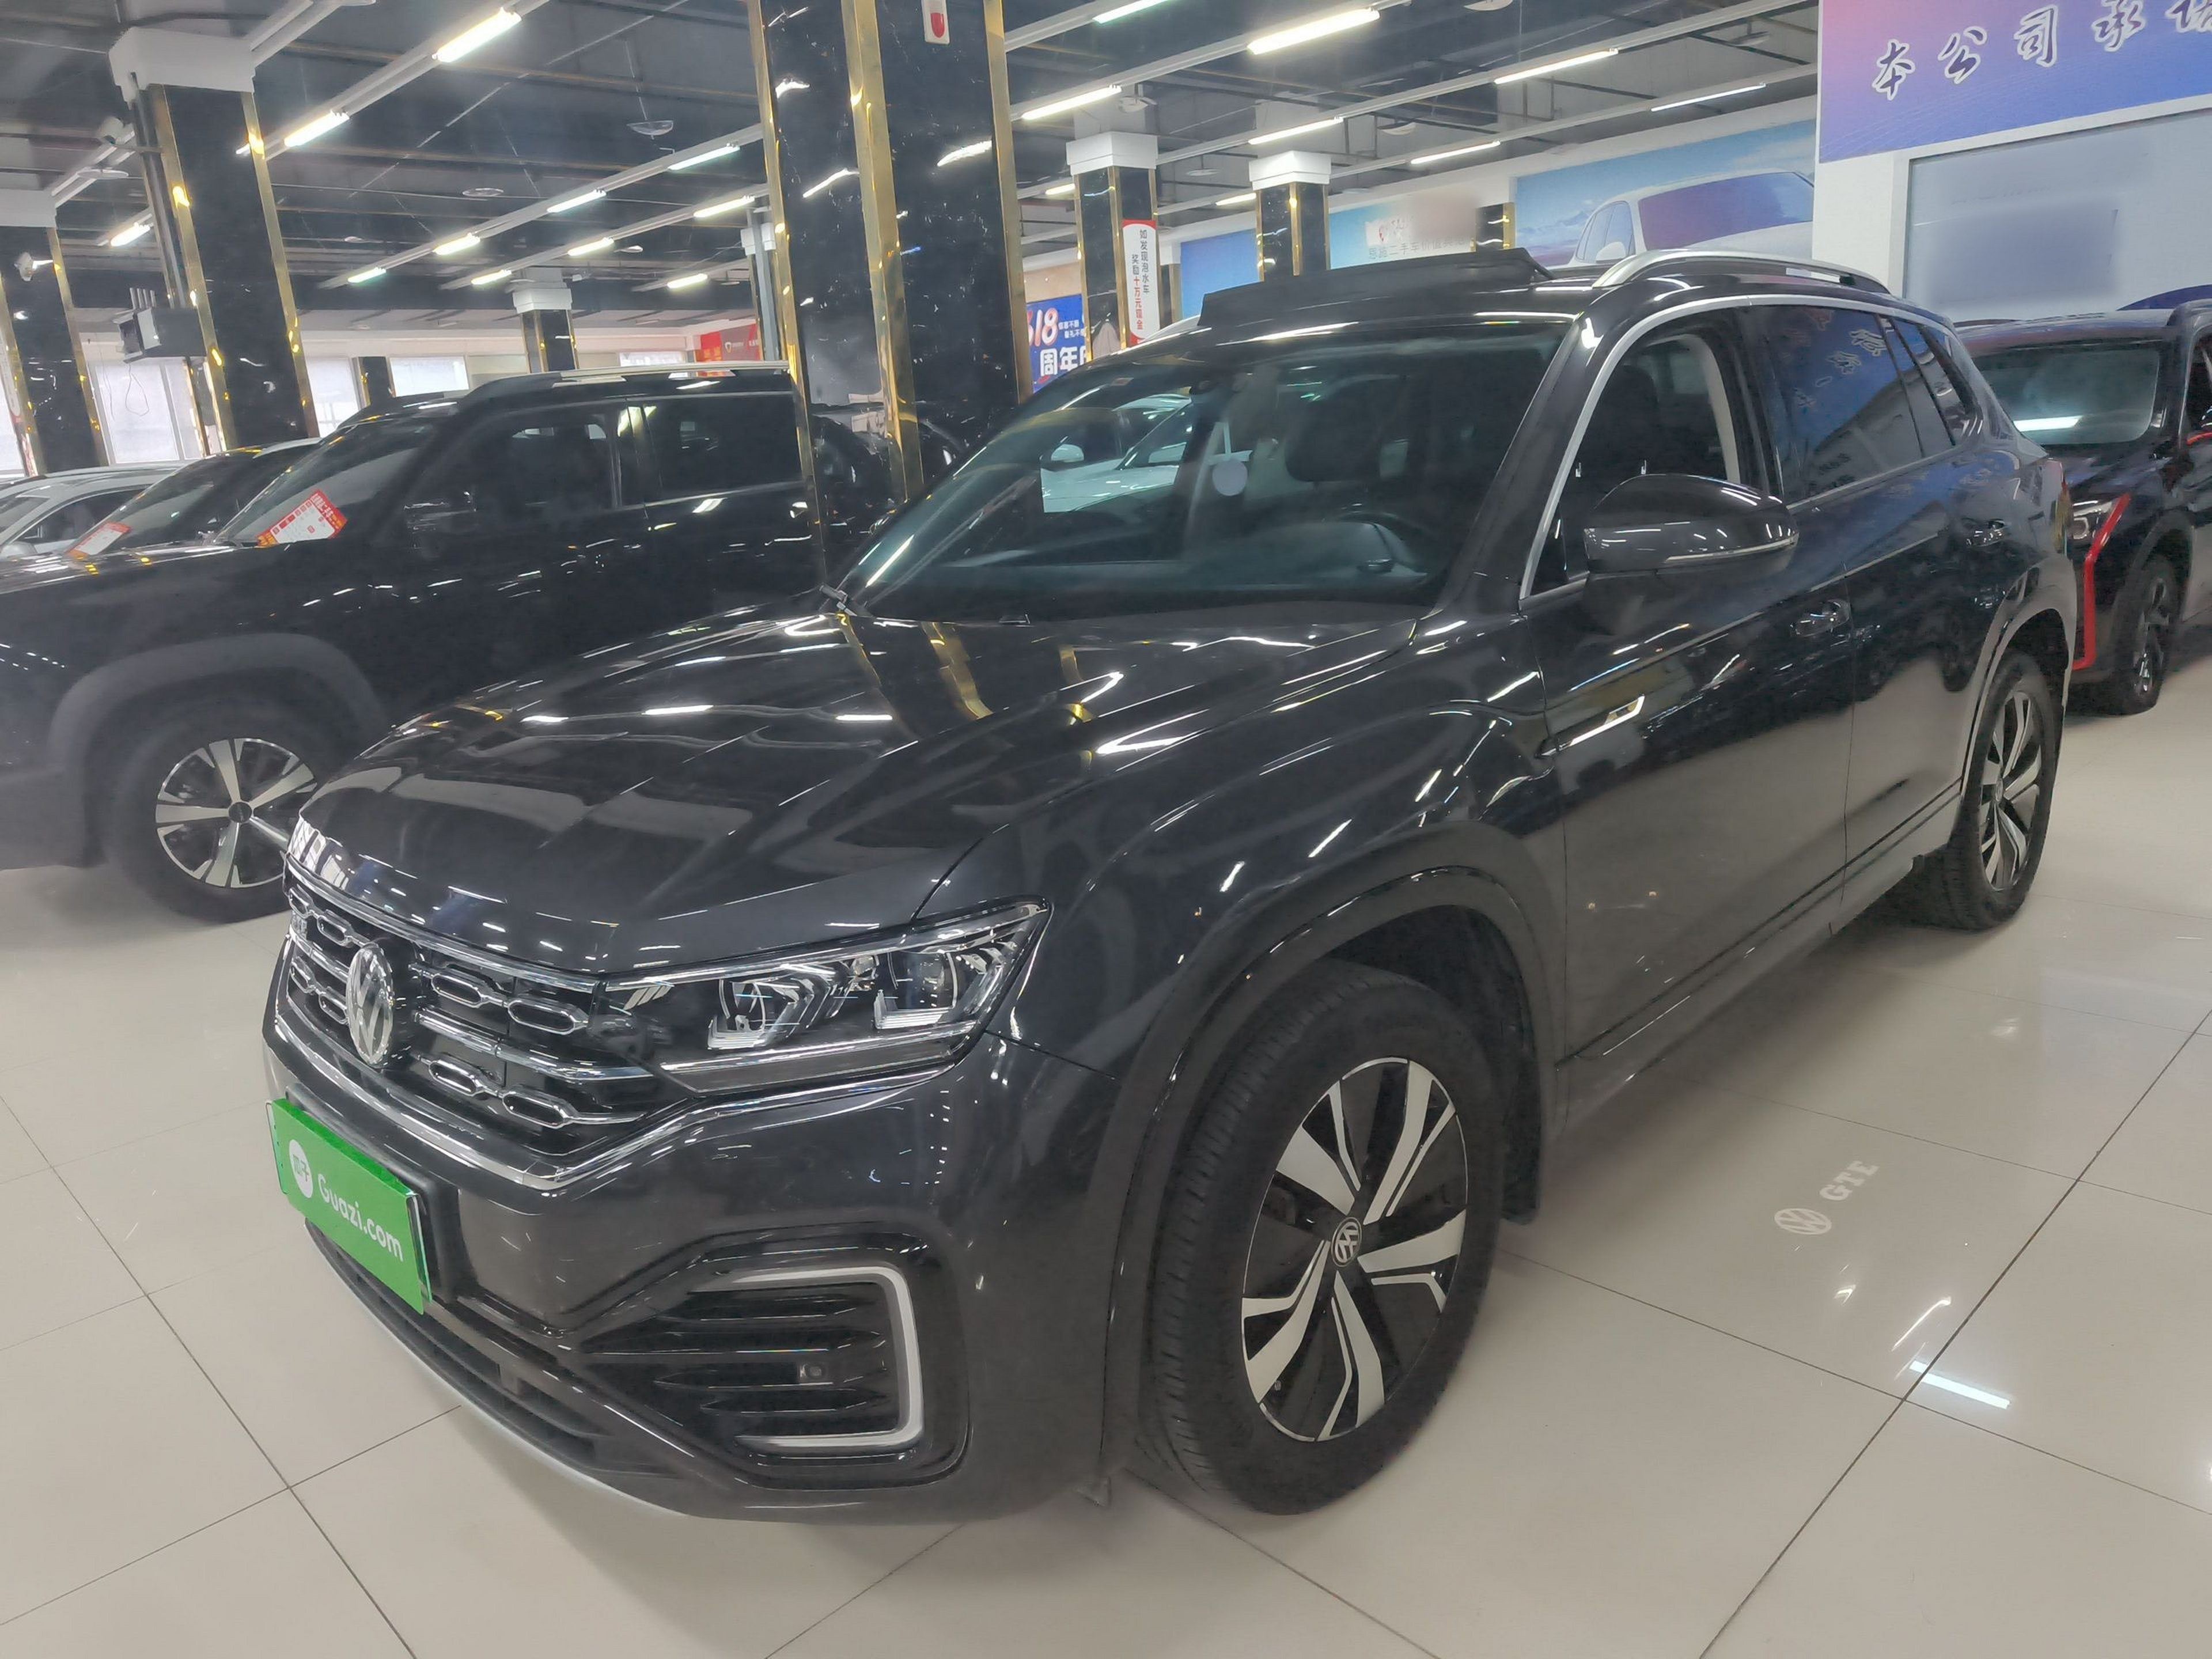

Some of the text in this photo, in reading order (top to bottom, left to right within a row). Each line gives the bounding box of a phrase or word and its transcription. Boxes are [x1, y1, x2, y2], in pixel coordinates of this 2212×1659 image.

[1132, 254, 1143, 330] 奖励十万元现金
[1140, 229, 1150, 294] 如发现泡水车
[1820, 1160, 1880, 1201] GTE
[318, 1173, 403, 1261] Guazi.com
